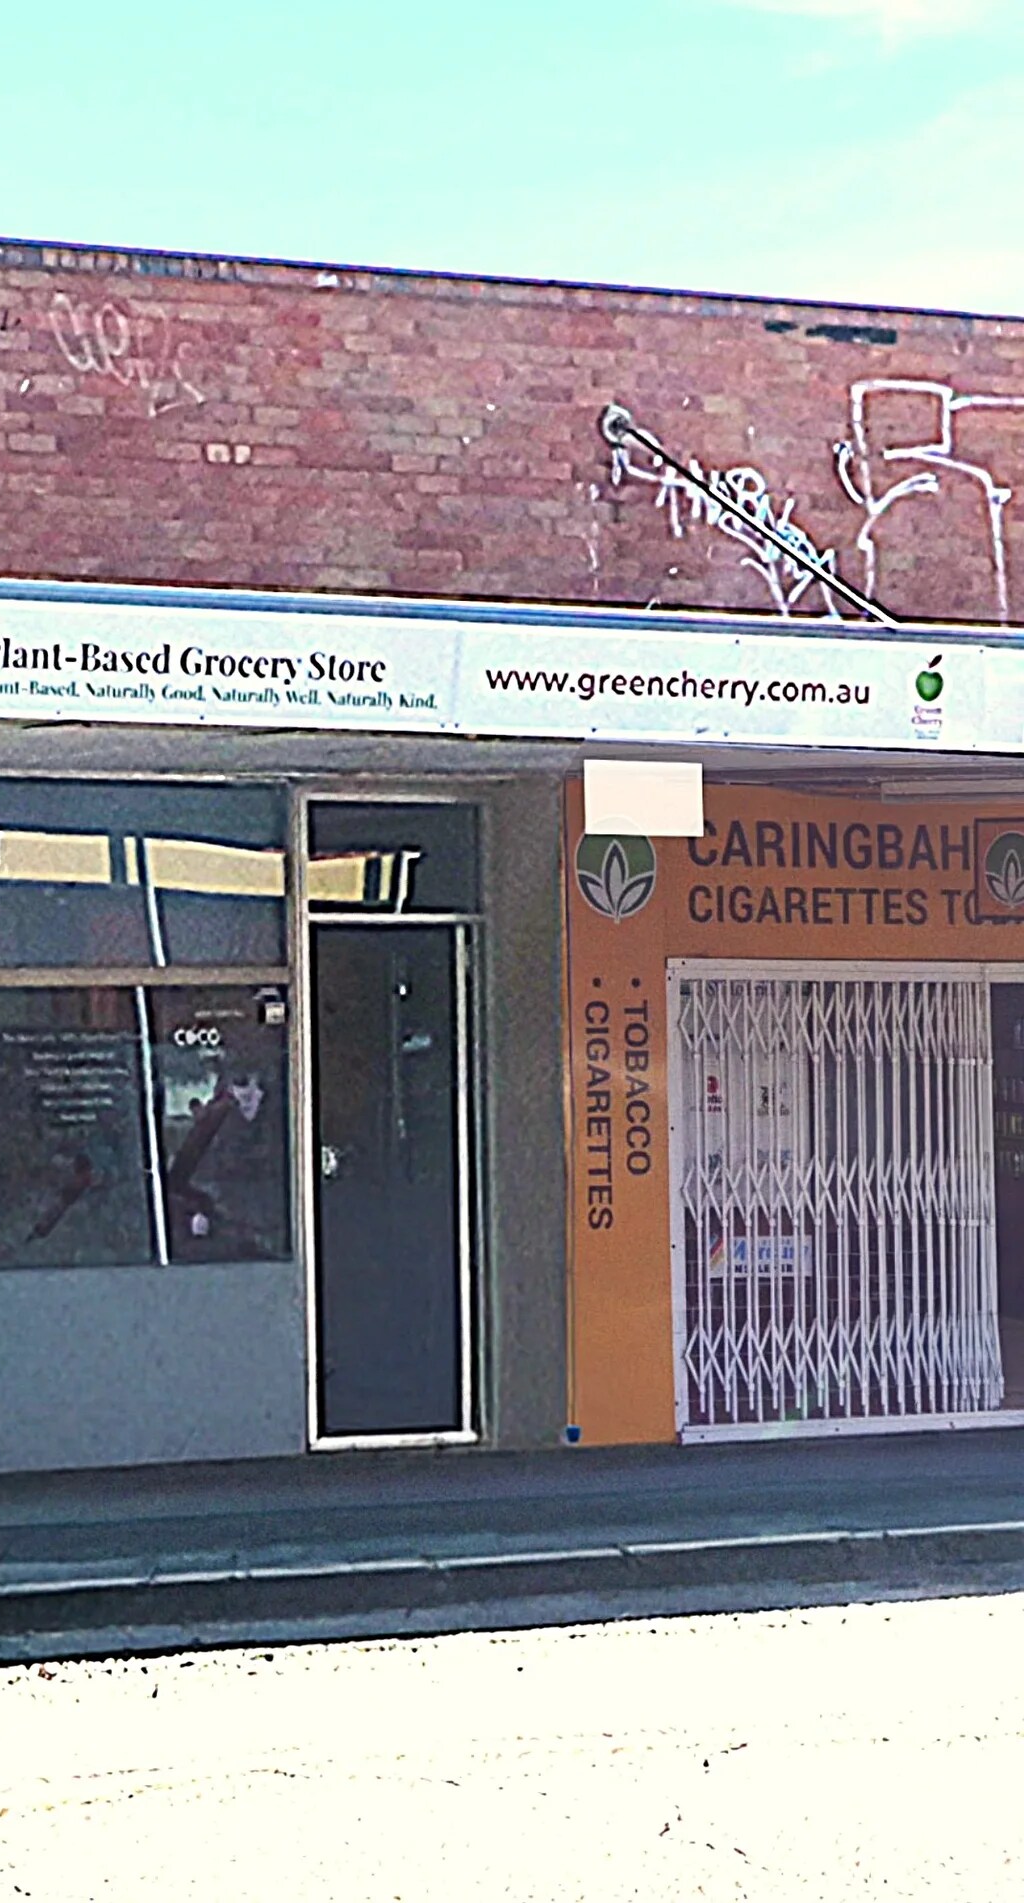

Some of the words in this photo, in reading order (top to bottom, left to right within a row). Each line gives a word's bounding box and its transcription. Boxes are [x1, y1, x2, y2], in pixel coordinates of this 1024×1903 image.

[180, 646, 302, 686] Grocery
[307, 651, 387, 683] Store
[485, 669, 870, 707] www.greencherry.com.au
[687, 818, 971, 871] CARINGBAH
[688, 884, 929, 926] CIGARETTES
[623, 999, 651, 1176] TOBACCO
[584, 1001, 614, 1230] CIGARETTES
